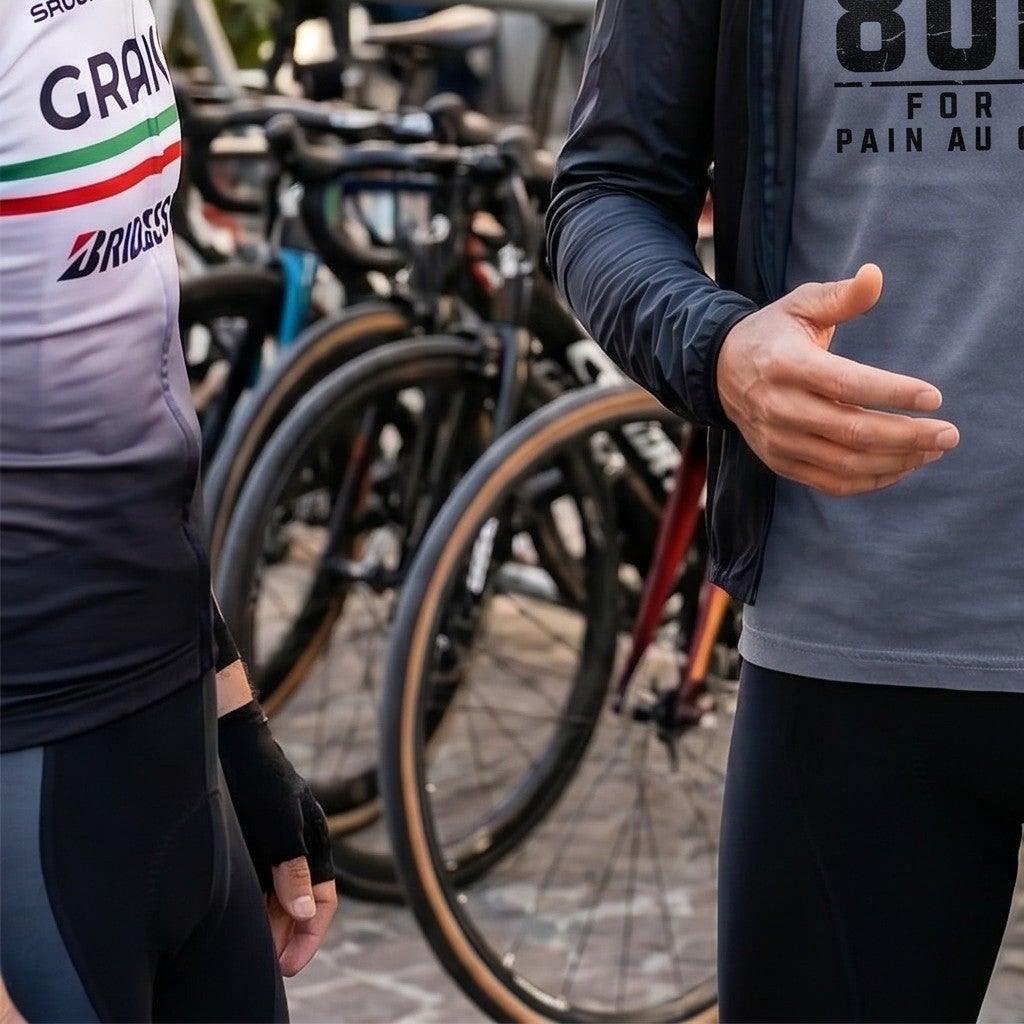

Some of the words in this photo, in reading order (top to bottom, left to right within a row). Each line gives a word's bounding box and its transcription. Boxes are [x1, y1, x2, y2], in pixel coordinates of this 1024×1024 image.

[906, 91, 993, 120] FOR
[836, 127, 922, 153] PAIN
[948, 126, 991, 152] AU
